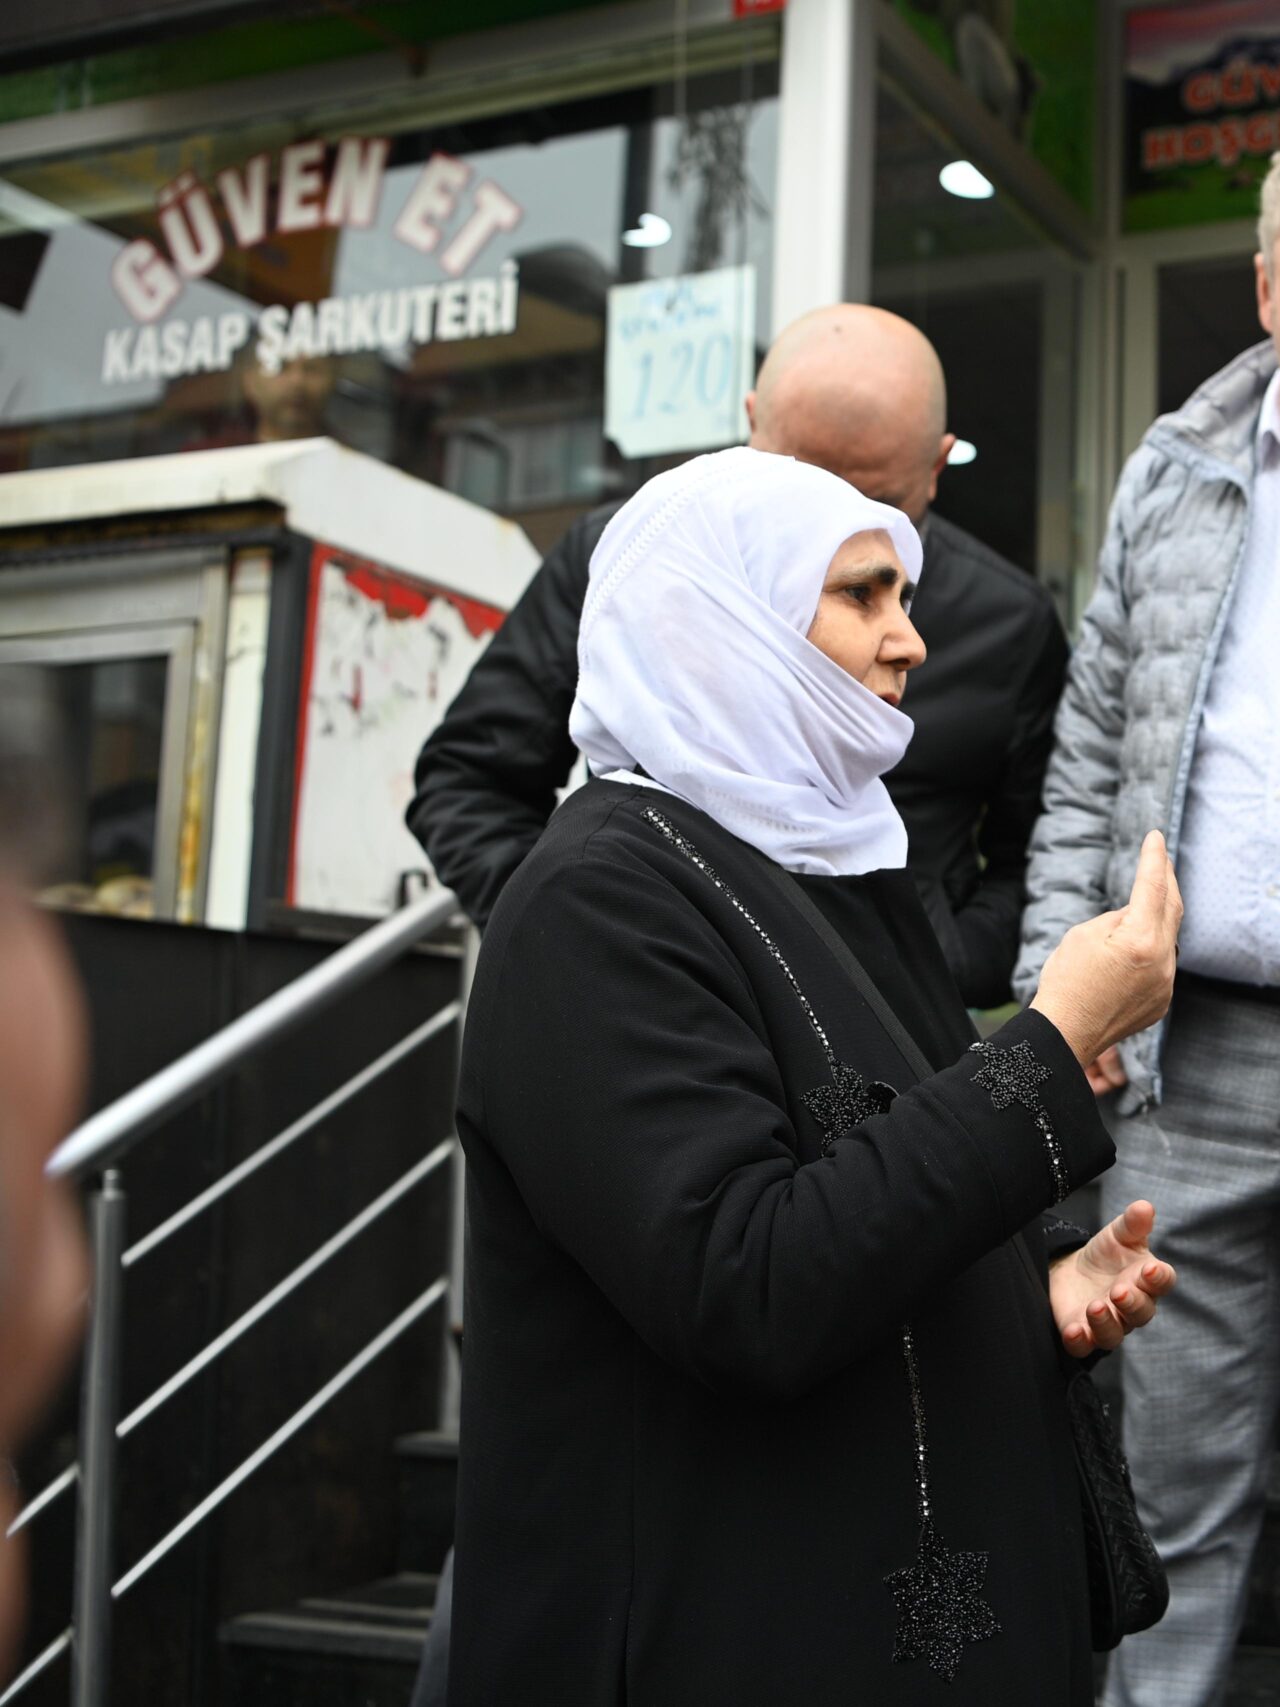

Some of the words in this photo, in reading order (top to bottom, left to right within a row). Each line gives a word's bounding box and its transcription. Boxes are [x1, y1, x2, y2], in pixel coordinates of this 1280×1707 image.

[111, 136, 391, 322] GÜVEN
[395, 152, 524, 276] ET
[103, 312, 250, 385] KASAP
[256, 259, 520, 375] ŞARKUTERİ
[631, 333, 733, 420] 120
